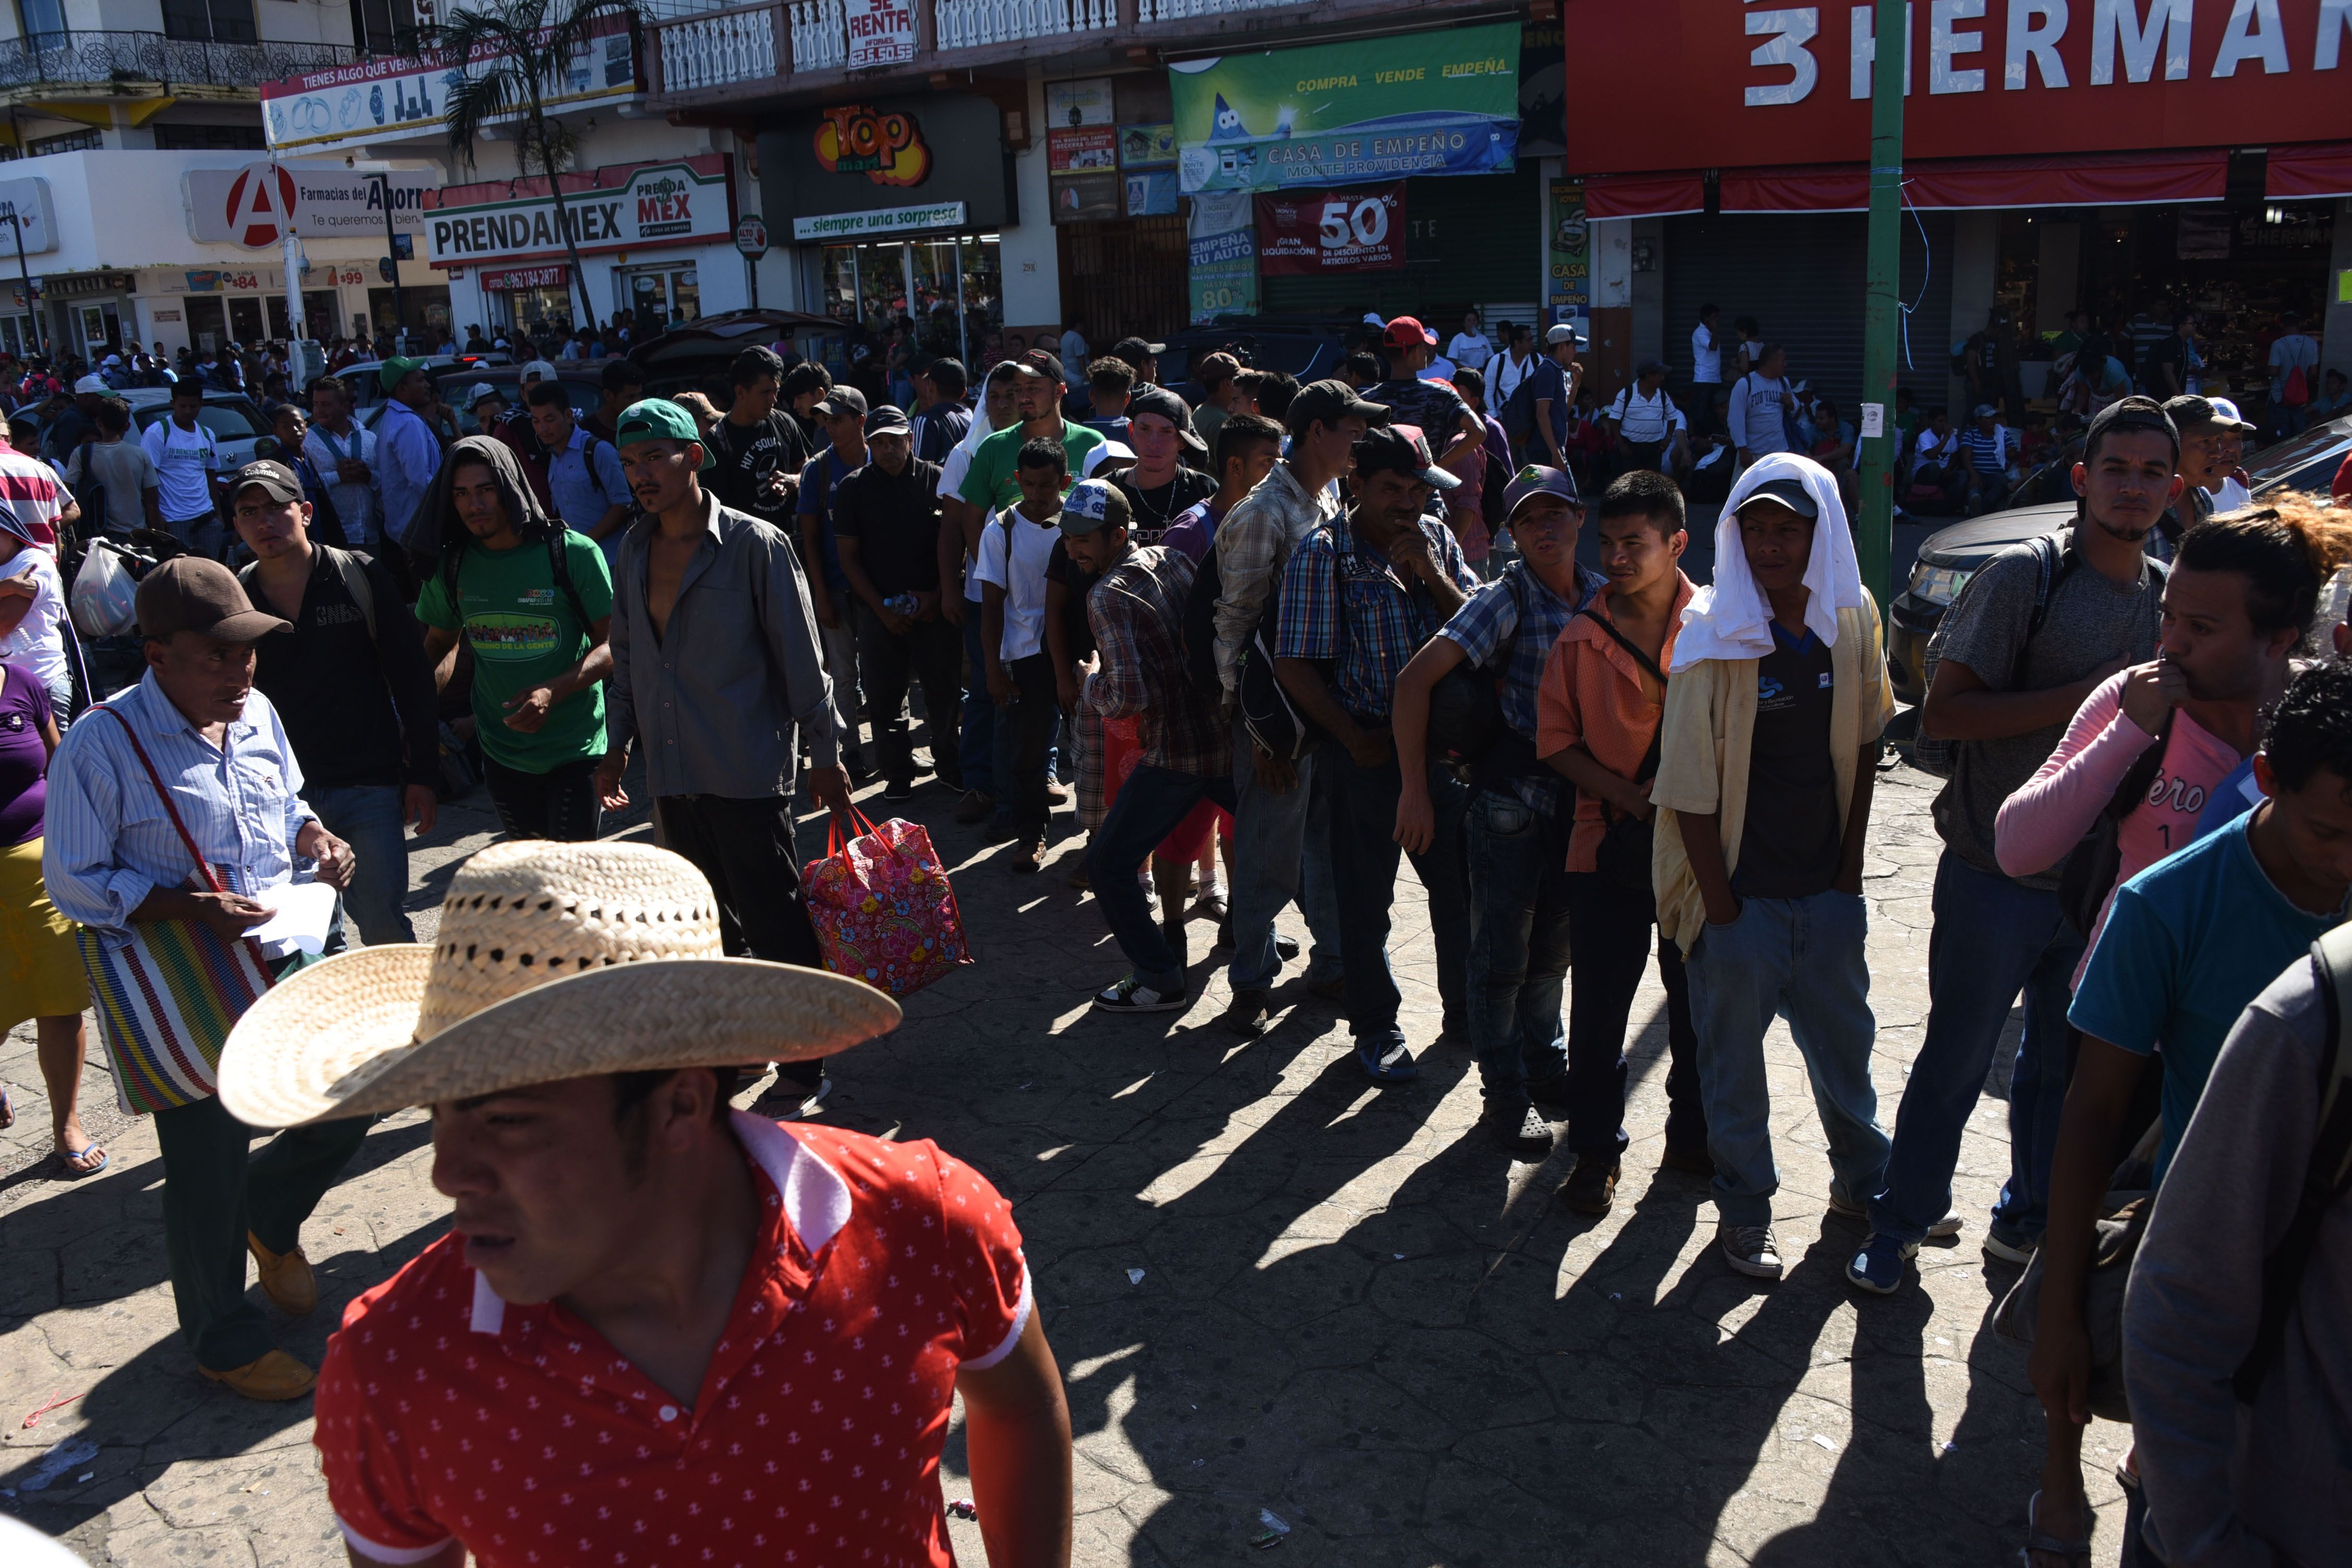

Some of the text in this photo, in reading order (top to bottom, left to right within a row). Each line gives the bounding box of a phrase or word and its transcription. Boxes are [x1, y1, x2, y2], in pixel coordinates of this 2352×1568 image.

[850, 9, 911, 39] RENTA
[851, 45, 913, 67] 62.6.50.53
[1744, 7, 1818, 107] 3
[302, 72, 335, 89] TIENES
[337, 66, 363, 82] ALGO
[365, 61, 387, 77] QUE
[1296, 57, 1506, 93] COMPRA VENDE EMPEÑA
[823, 105, 911, 166] Top
[1267, 129, 1466, 164] CASA DE EMPEÑO
[837, 156, 880, 172] mart
[1287, 154, 1447, 179] MONTE PROVIDENCIA
[300, 186, 349, 201] Farmacias
[352, 187, 366, 201] del
[637, 180, 686, 197] PRENDA
[638, 194, 692, 224] MEX
[312, 214, 325, 226] Te
[434, 202, 622, 255] PRENDAMEX
[672, 223, 690, 232] EMPEÑO
[813, 217, 863, 234] siempre
[868, 213, 893, 227] una
[897, 207, 957, 226] sorpresa
[1319, 194, 1398, 249] 50%
[739, 229, 753, 238] ALTO
[1277, 237, 1301, 248] ¡GRAN
[1190, 233, 1249, 254] EMPEÑA
[1261, 246, 1316, 256] LIQUIDACIÓN!
[1334, 246, 1376, 256] DESCUENTO
[1190, 244, 1252, 266] TU AUTO
[1363, 253, 1392, 261] VARIOS
[1204, 263, 1252, 273] PRESTAMOS
[1551, 265, 1587, 277] CASA
[232, 275, 259, 289] $84
[340, 272, 363, 285] $99
[510, 272, 524, 289] 962
[524, 270, 539, 287] 184
[540, 267, 559, 285] 2877
[1563, 282, 1575, 290] DE
[1202, 288, 1243, 310] 80%
[1550, 293, 1587, 304] EMPEÑO
[1751, 390, 1781, 408] FUN VALL
[740, 450, 755, 470] HIT
[244, 468, 280, 480] Columbia
